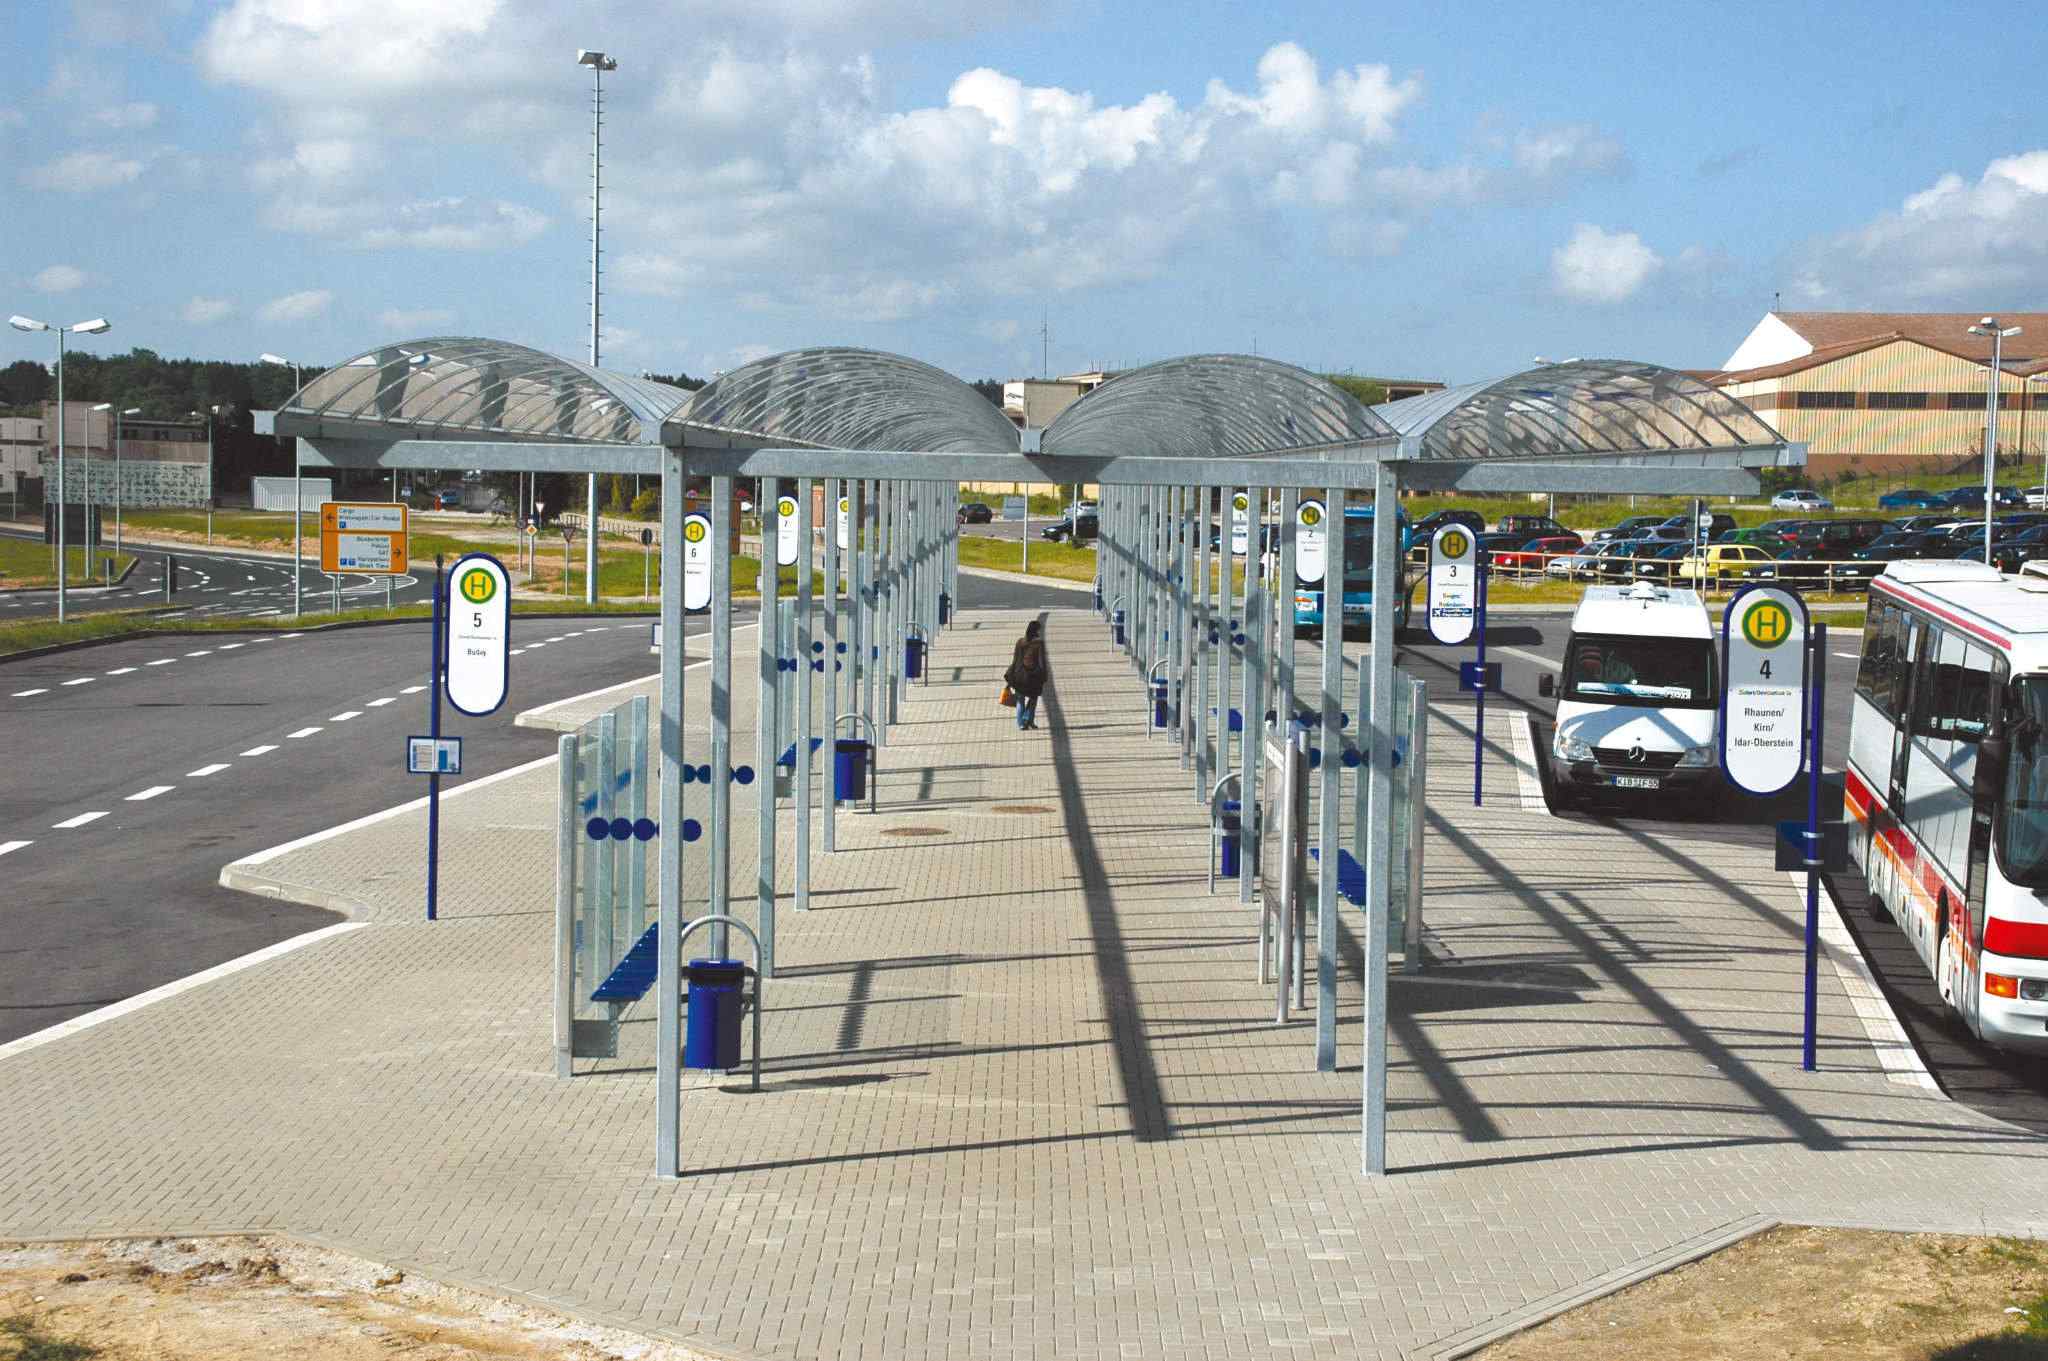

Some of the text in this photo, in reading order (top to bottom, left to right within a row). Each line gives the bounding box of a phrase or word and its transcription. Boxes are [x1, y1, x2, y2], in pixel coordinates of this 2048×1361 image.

[691, 548, 697, 558] 6
[1450, 565, 1457, 577] 3
[471, 576, 486, 595] H
[473, 612, 482, 628] 5
[1757, 611, 1778, 638] H
[1759, 659, 1772, 679] 4
[1744, 707, 1785, 717] Rhaunen/
[1753, 722, 1775, 732] Kirn/
[1734, 737, 1794, 747] Idar-Oberstein
